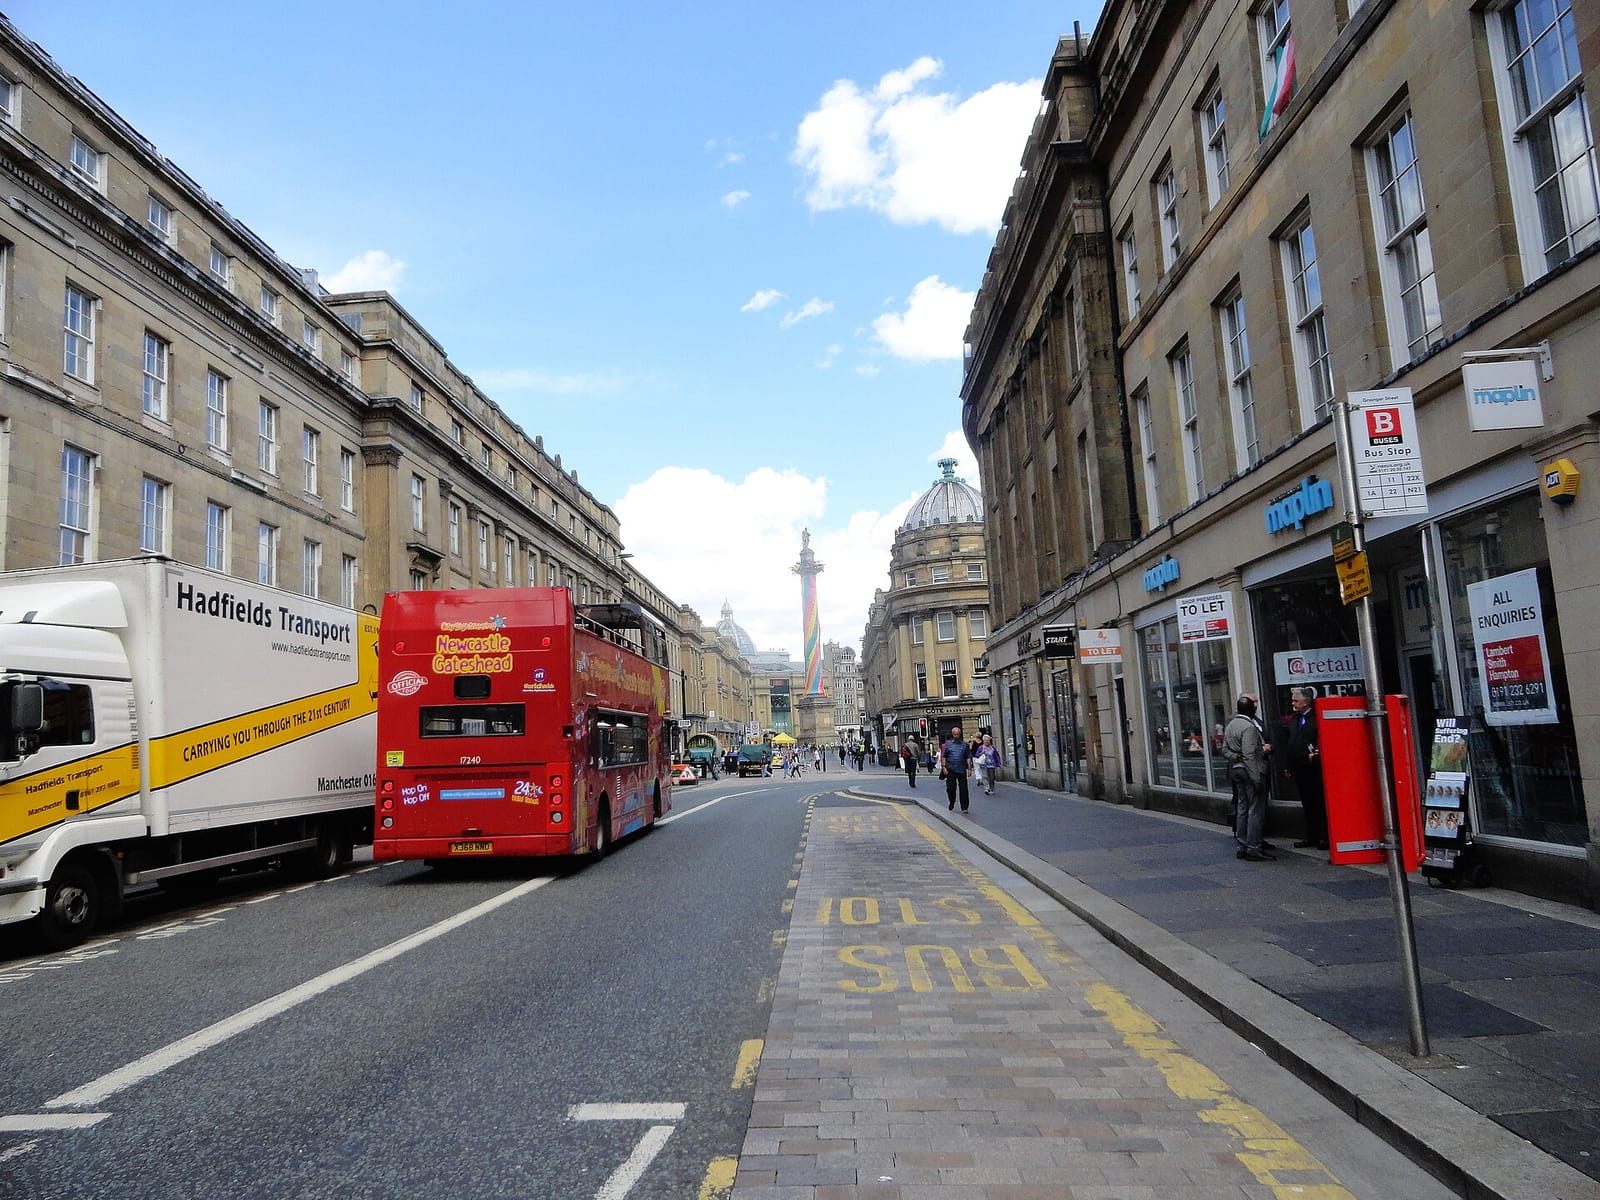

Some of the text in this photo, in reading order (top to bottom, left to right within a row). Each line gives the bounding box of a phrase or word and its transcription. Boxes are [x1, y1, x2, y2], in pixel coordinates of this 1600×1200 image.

[1473, 384, 1536, 406] maplin
[1373, 412, 1394, 433] B
[1373, 436, 1399, 445] BUSES
[1365, 447, 1412, 458] Bus Stop
[1547, 472, 1559, 487] ADT
[1407, 486, 1421, 494] N21
[1264, 476, 1334, 534] maplin
[1143, 554, 1180, 592] maplin
[1197, 594, 1222, 602] PREMISES
[1493, 590, 1512, 606] ALL
[177, 581, 350, 644] Hadfields Transport
[1180, 600, 1225, 616] TO LET
[1478, 606, 1536, 629] ENQUIRIES
[436, 633, 511, 653] Newcastle
[1045, 636, 1068, 645] START
[271, 641, 351, 663] www.hadfieldstransport.com
[1101, 647, 1117, 655] LET
[1485, 645, 1514, 658] Lambert
[433, 654, 513, 673] Gateshead
[1289, 653, 1360, 675] @retail
[1487, 657, 1507, 669] Smith
[1489, 669, 1519, 681] Hampton
[391, 677, 424, 690] OFFICIAL
[1510, 684, 1524, 696] 232
[1525, 682, 1544, 694] 6291
[183, 697, 351, 763] CARRYING YOU THROUGH THE 21st CENTURY
[1436, 718, 1456, 728] Will
[1434, 734, 1461, 744] End?
[1435, 727, 1468, 736] Suffering
[460, 756, 481, 765] 17240
[25, 764, 103, 795] Hadfields Transport
[318, 775, 362, 792] Manchester
[402, 784, 428, 796] Hop On
[513, 780, 529, 795] 24
[403, 792, 430, 806] Hop Off
[27, 799, 63, 817] Manchester
[837, 943, 1052, 994] BUS
